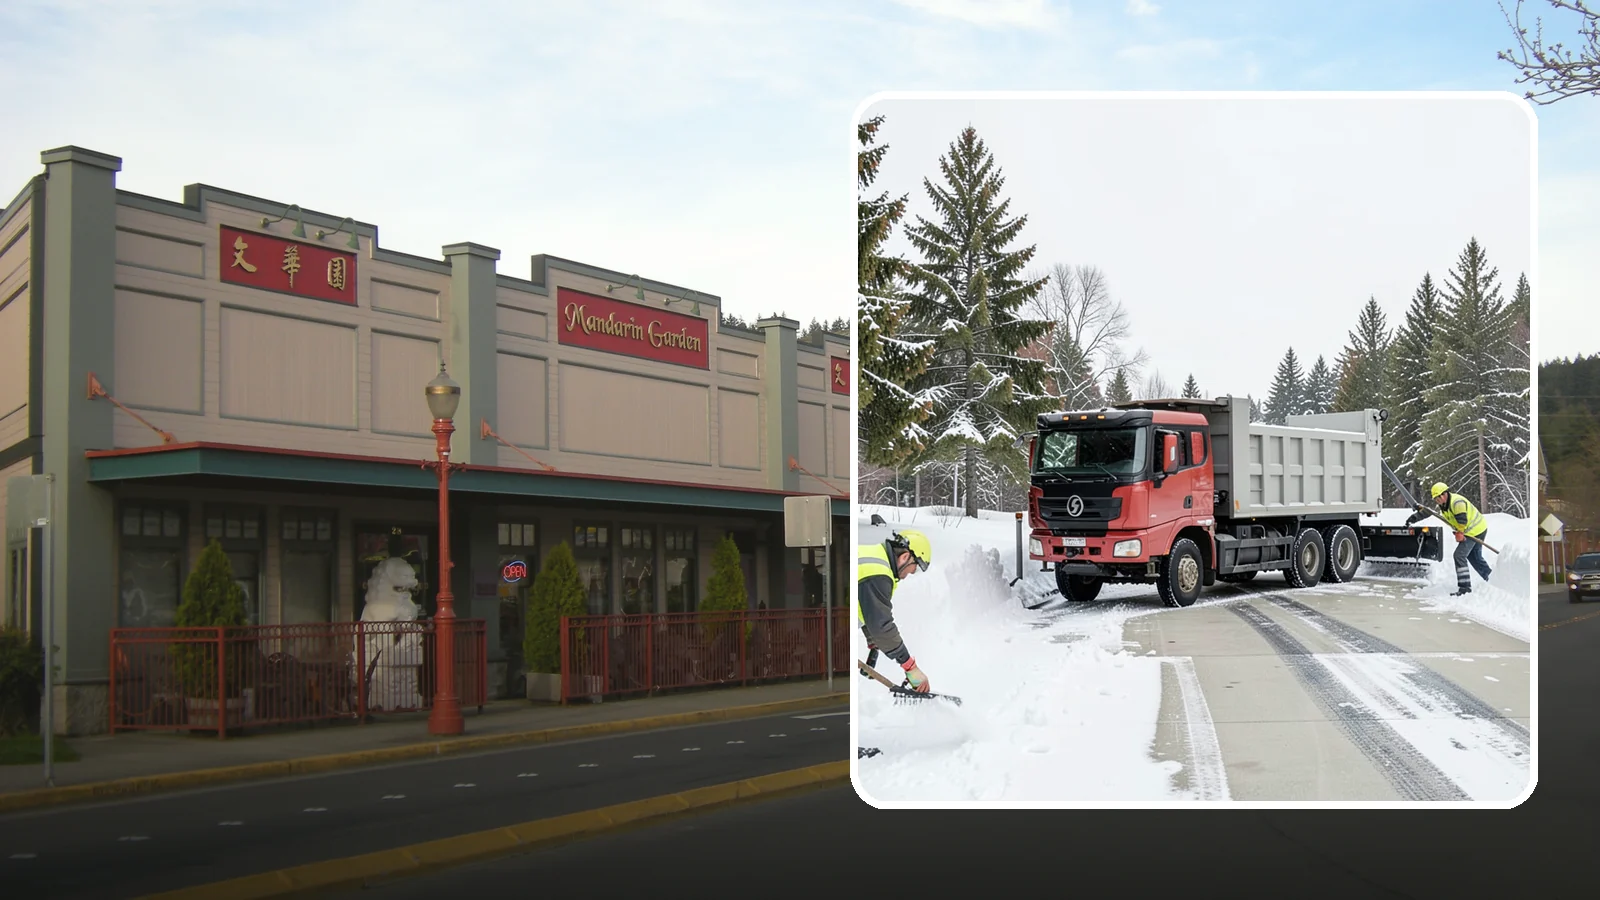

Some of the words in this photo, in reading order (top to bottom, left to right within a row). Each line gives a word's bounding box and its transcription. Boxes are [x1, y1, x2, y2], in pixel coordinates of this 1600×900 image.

[564, 302, 644, 344] Mandarin
[648, 320, 701, 352] Garden
[503, 565, 527, 578] OPEN
